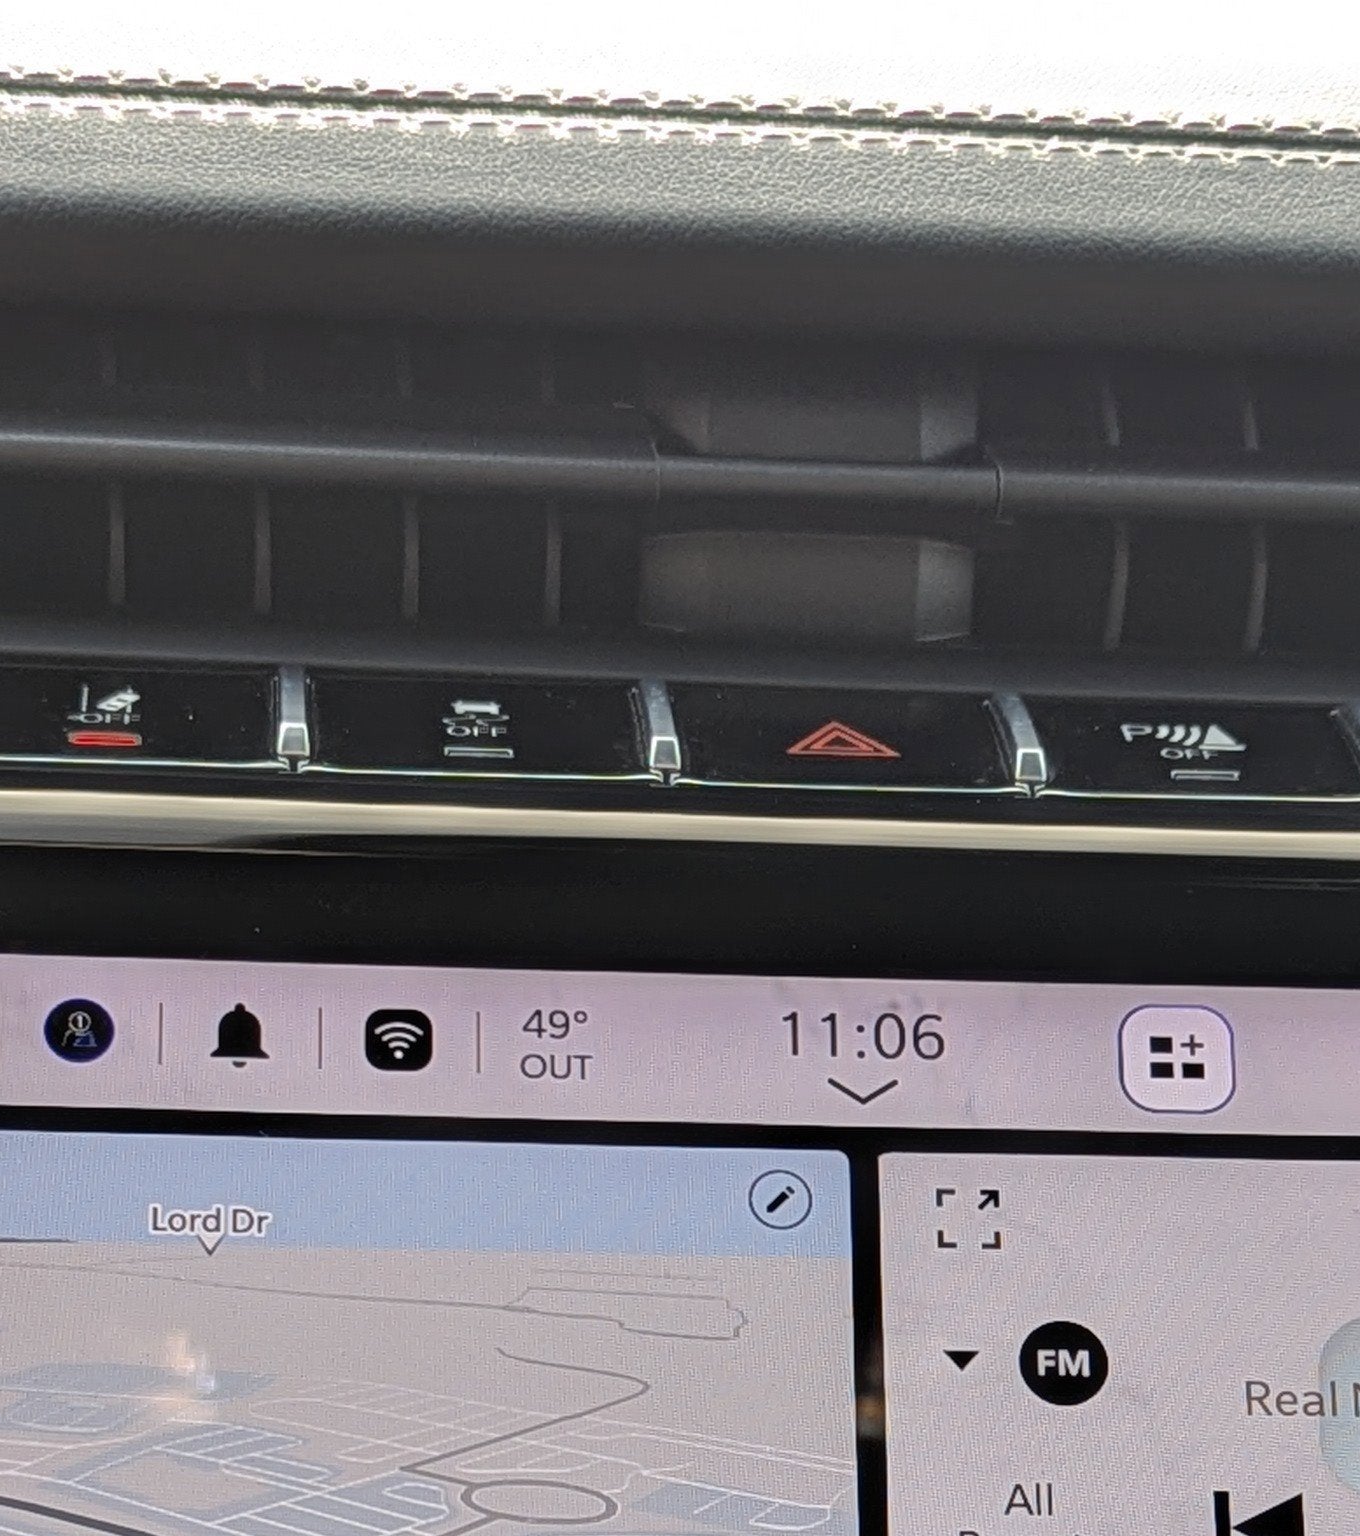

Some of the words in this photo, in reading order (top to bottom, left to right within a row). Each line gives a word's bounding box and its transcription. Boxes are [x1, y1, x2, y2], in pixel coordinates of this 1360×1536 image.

[80, 713, 141, 725] OFF
[522, 1009, 589, 1040] 49°
[781, 1011, 946, 1060] 11:06
[520, 1054, 593, 1081] OUT
[151, 1206, 221, 1234] Lord
[231, 1208, 270, 1235] Dr
[1037, 1349, 1091, 1378] FM
[1246, 1380, 1337, 1417] Real
[1005, 1483, 1054, 1517] All
